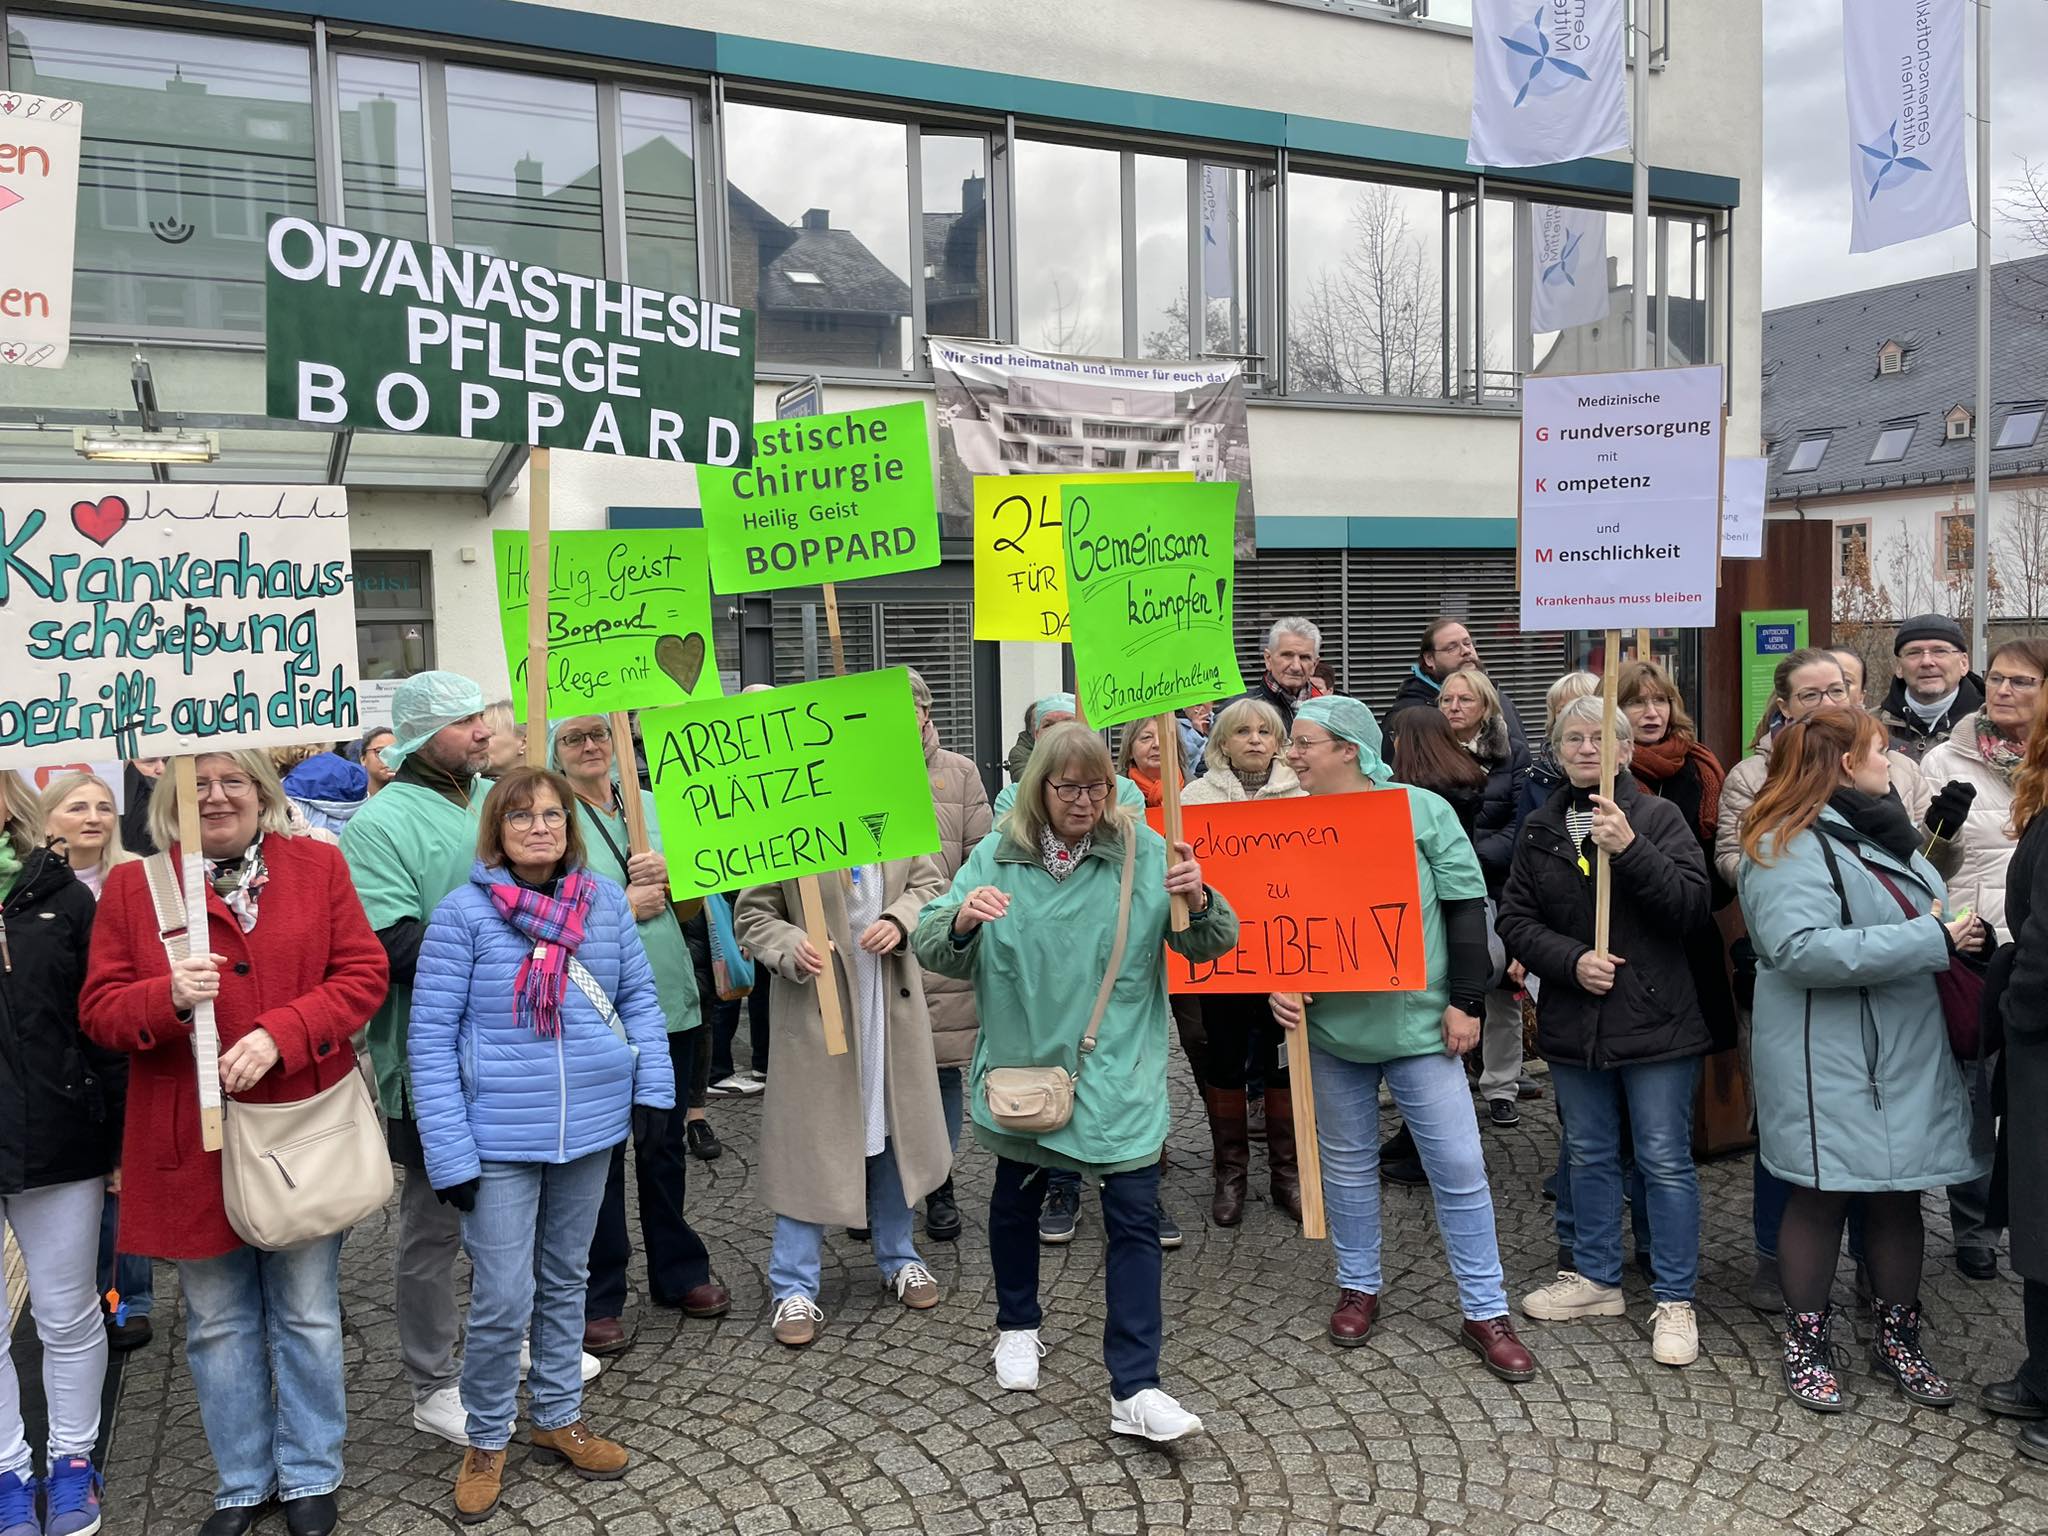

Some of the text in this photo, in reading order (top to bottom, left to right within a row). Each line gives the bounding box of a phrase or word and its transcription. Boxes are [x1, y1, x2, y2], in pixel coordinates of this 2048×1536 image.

[267, 216, 742, 357] OP/ANÄSTHESIE
[407, 305, 642, 398] PFLEGE
[939, 350, 1227, 384] Wir sind heimatnah und immer für euch da!
[297, 360, 741, 467] BOPPARD
[1577, 392, 1661, 408] Medizinische
[732, 453, 904, 500] Chirurgie
[1597, 451, 1618, 462] mit
[743, 501, 860, 531] Heilig Geist
[1596, 522, 1620, 534] und
[745, 526, 917, 576] BOPPARD
[1068, 495, 1210, 582] Gemeinsam
[606, 543, 682, 602] Geist
[1007, 562, 1058, 593] FÜR
[1535, 592, 1702, 607] Krankenhaus muss bleiben
[26, 602, 321, 677] schließung
[547, 602, 657, 644] Boppard
[620, 655, 651, 684] mit
[1087, 664, 1228, 718] #Standorterhaltung
[171, 669, 261, 738] auch
[267, 661, 359, 730] dich
[682, 758, 832, 827] PLÄTZE
[1192, 822, 1339, 859] ekommen
[1266, 882, 1290, 899] zu
